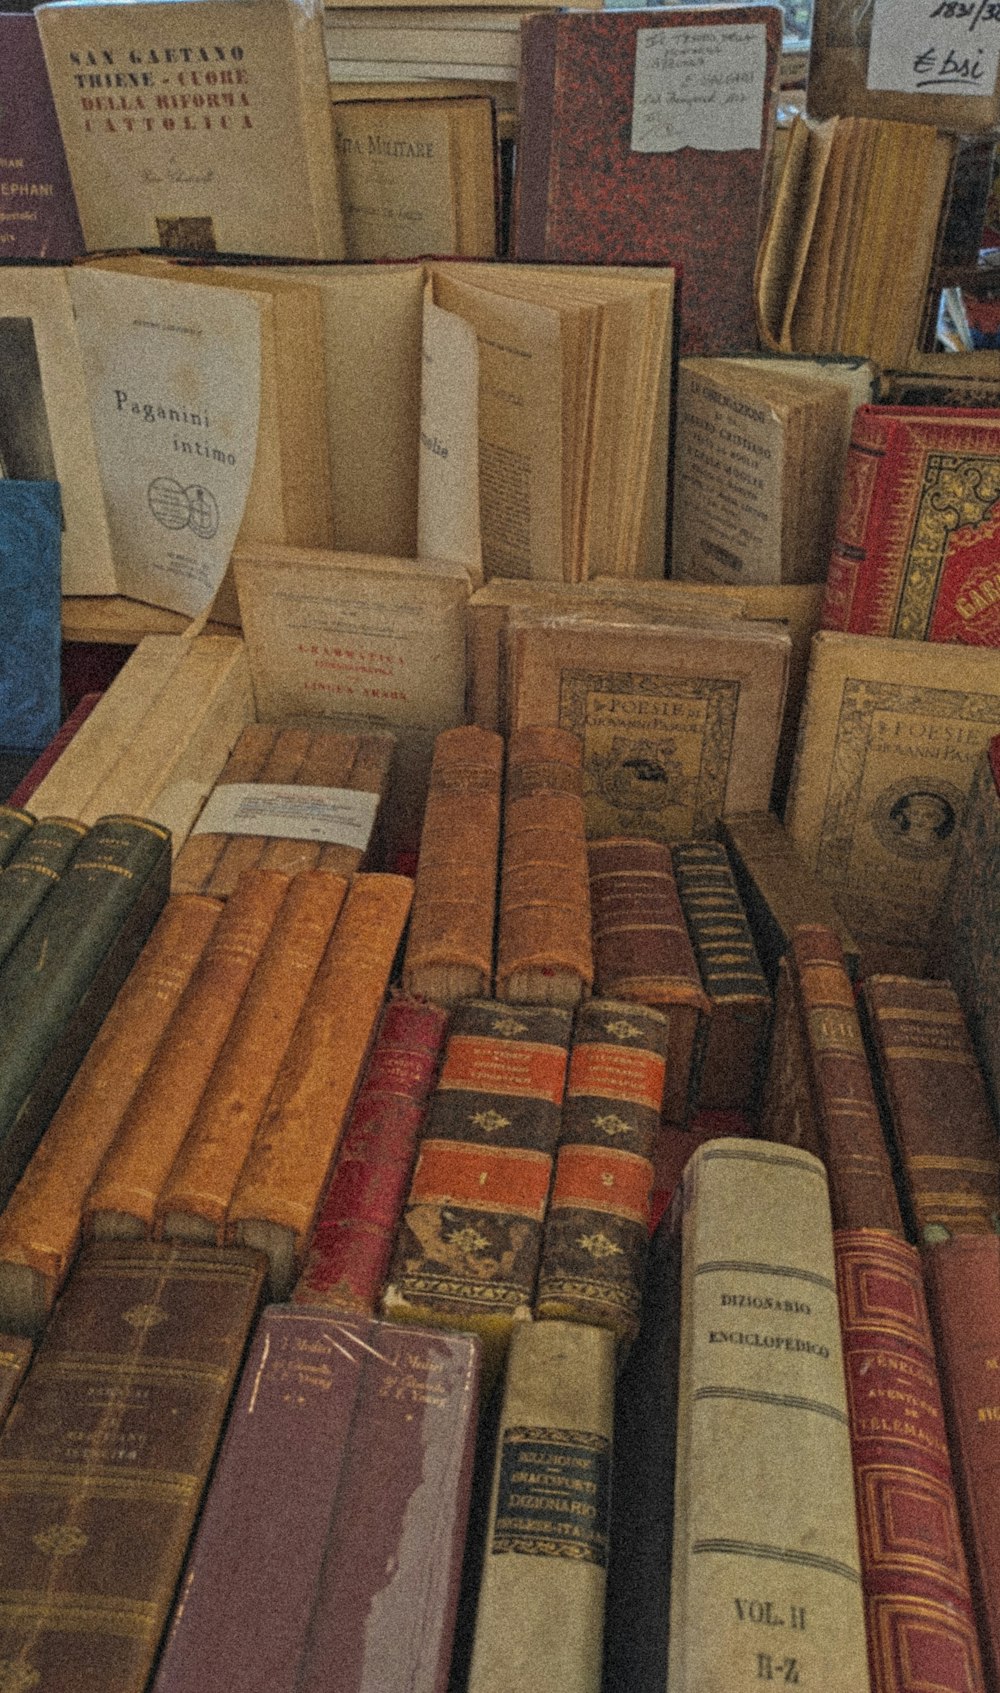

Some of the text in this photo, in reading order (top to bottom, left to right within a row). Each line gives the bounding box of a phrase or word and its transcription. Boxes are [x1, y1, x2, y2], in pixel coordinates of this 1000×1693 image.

[69, 46, 245, 66] SAN GAETANO
[74, 72, 154, 89] THIENE
[177, 69, 248, 87] CUORE
[81, 92, 251, 111] DELLA RIFORMA
[84, 115, 253, 133] CATTOLICA
[115, 389, 210, 428] Paganini
[173, 433, 237, 466] intimo
[609, 699, 684, 718] POESIE
[894, 720, 981, 745] POESIE
[721, 1293, 812, 1316] DIZIONARIO
[708, 1330, 831, 1360] ENCICLOPEDICO
[735, 1597, 807, 1630] VOL. II
